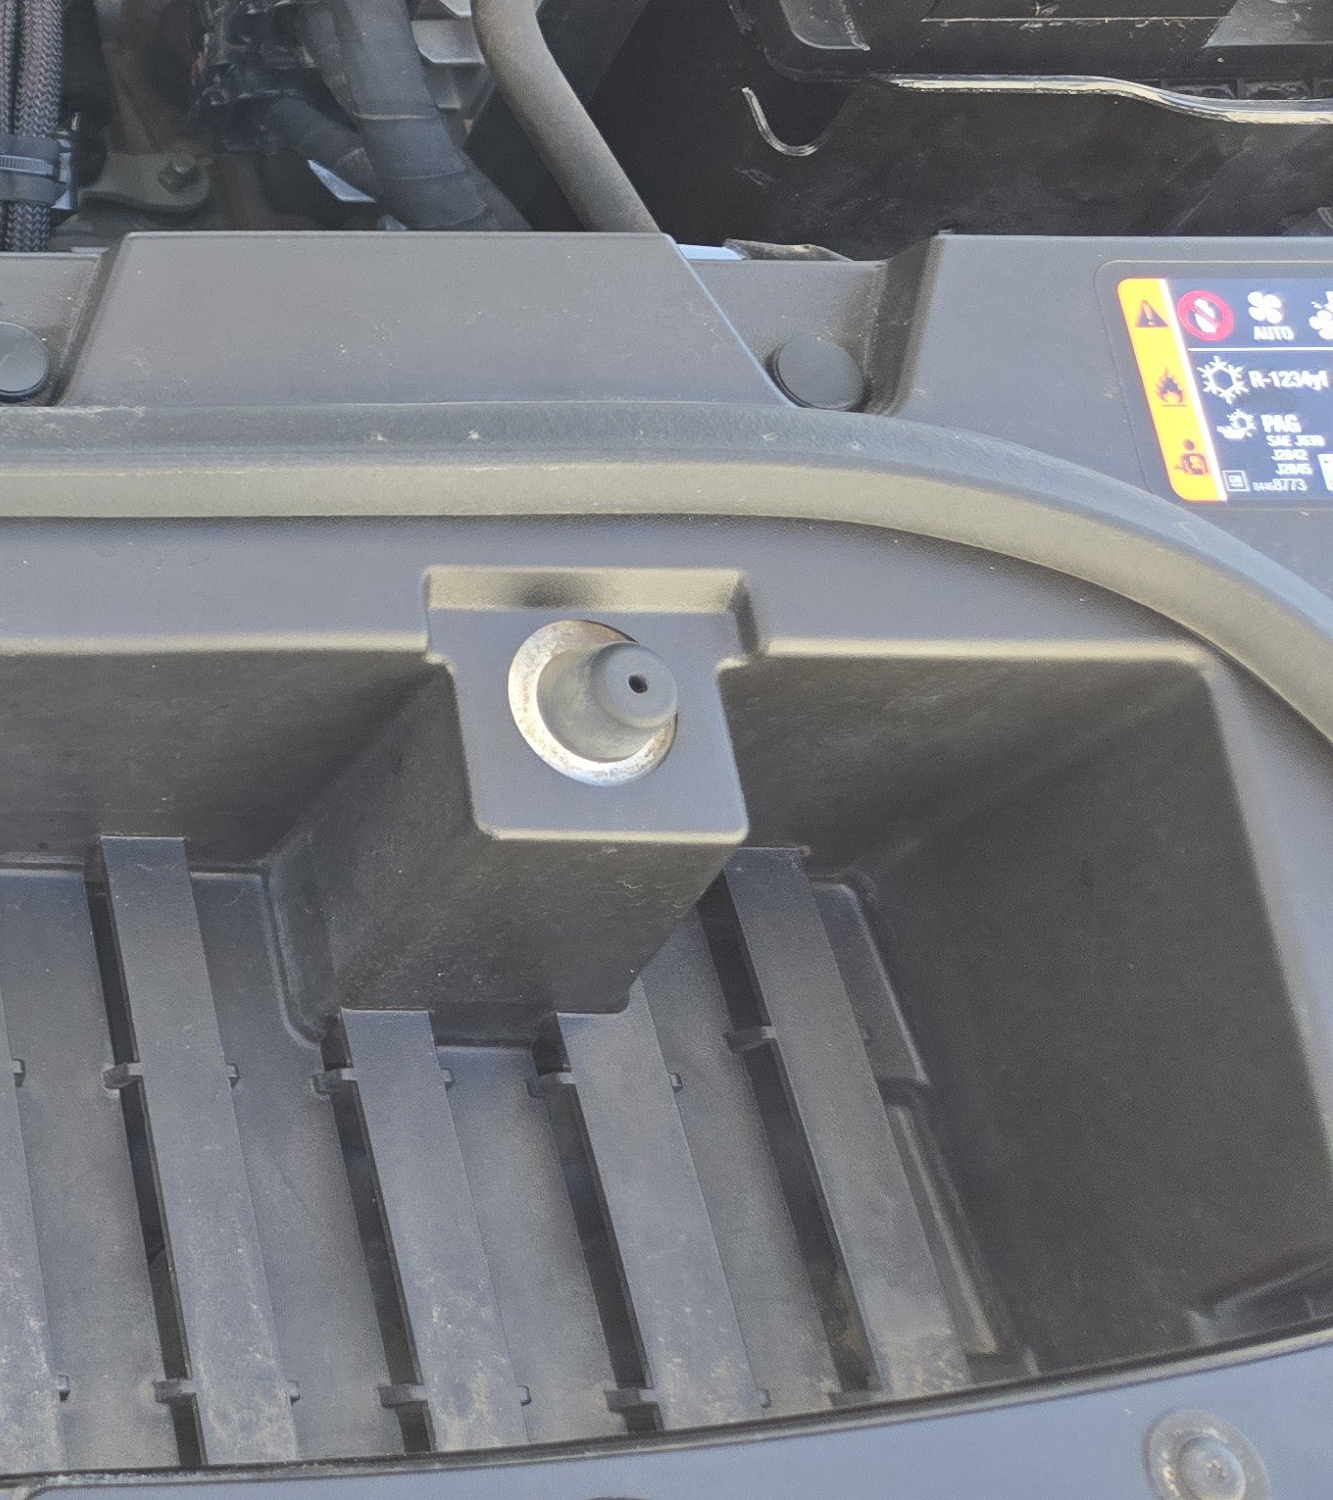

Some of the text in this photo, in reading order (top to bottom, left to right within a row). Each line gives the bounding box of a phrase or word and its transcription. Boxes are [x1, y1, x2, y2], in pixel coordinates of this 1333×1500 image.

[1253, 326, 1294, 341] AUTO
[1249, 370, 1329, 391] R-1234yf
[1260, 414, 1302, 433] PAG
[1266, 435, 1292, 447] SAE
